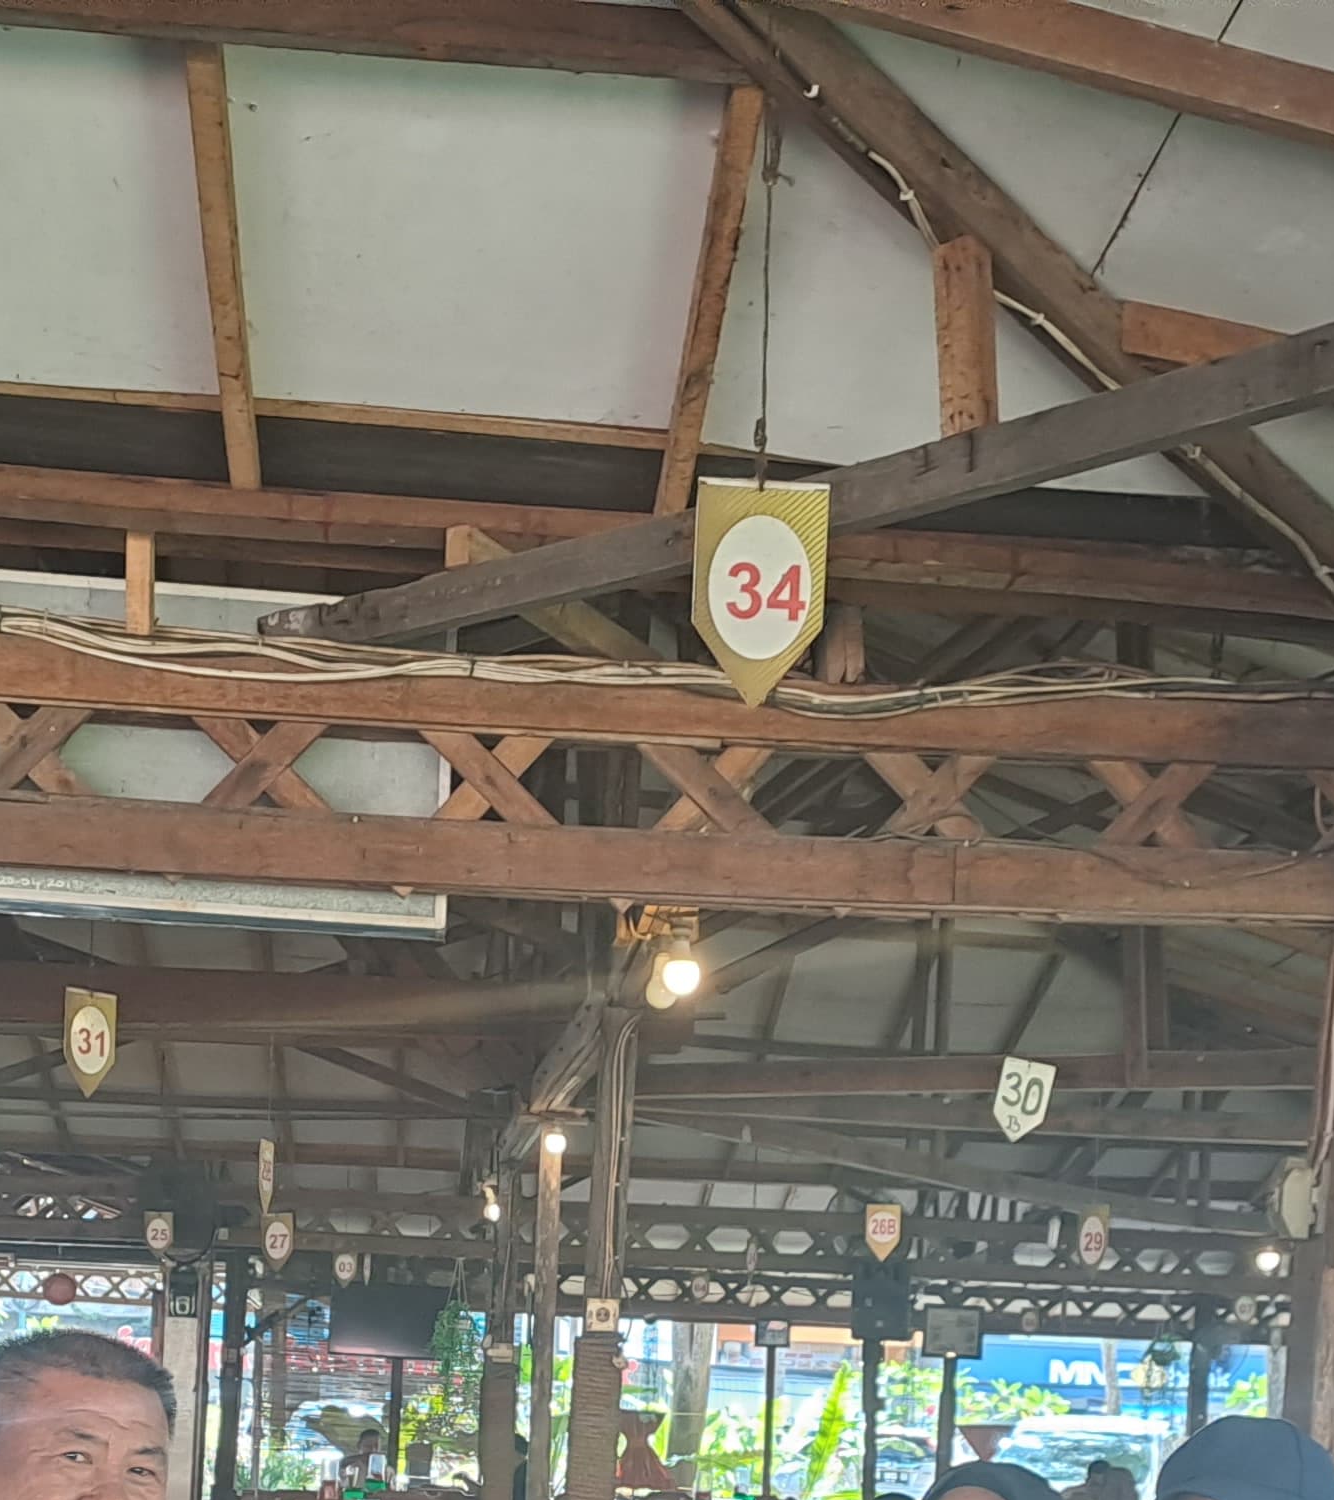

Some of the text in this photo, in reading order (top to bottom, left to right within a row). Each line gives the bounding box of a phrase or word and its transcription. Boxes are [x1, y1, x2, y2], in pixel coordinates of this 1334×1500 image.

[726, 562, 806, 622] 34
[77, 1027, 106, 1057] 31
[1001, 1071, 1044, 1116] 30
[1006, 1115, 1021, 1133] B
[150, 1228, 168, 1241] 25
[871, 1218, 897, 1236] 26B
[269, 1234, 288, 1250] 27
[1083, 1231, 1104, 1252] 29
[338, 1262, 353, 1273] 03
